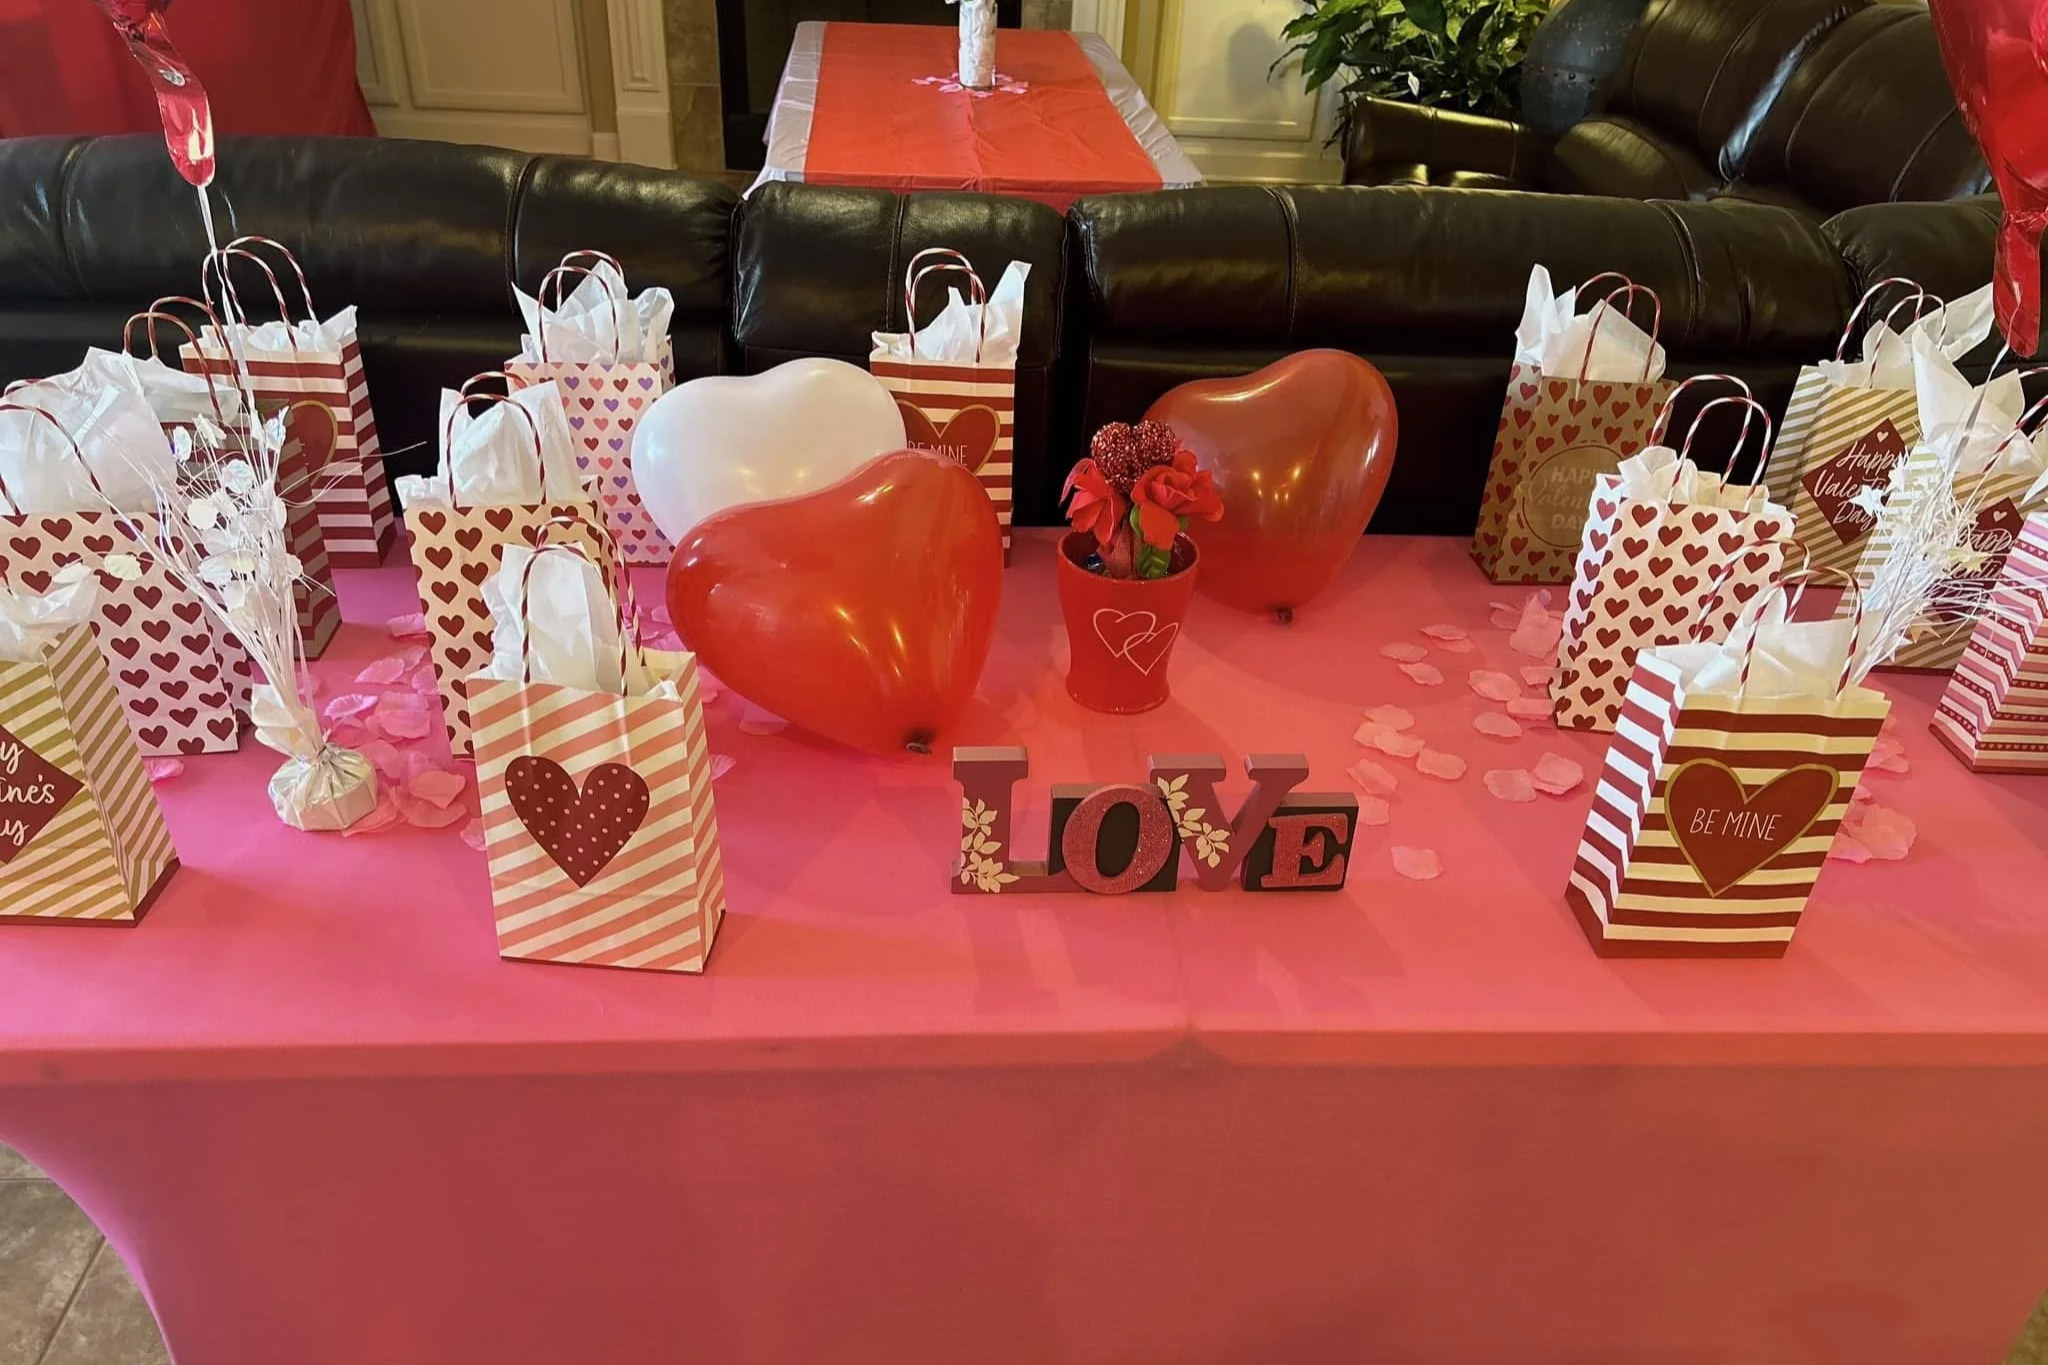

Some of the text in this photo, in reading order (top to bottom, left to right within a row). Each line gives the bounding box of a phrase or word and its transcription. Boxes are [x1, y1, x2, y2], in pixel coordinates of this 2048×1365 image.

[1550, 465, 1597, 485] HAP
[951, 746, 1352, 894] LOVE
[1689, 807, 1783, 841] BE MINE
